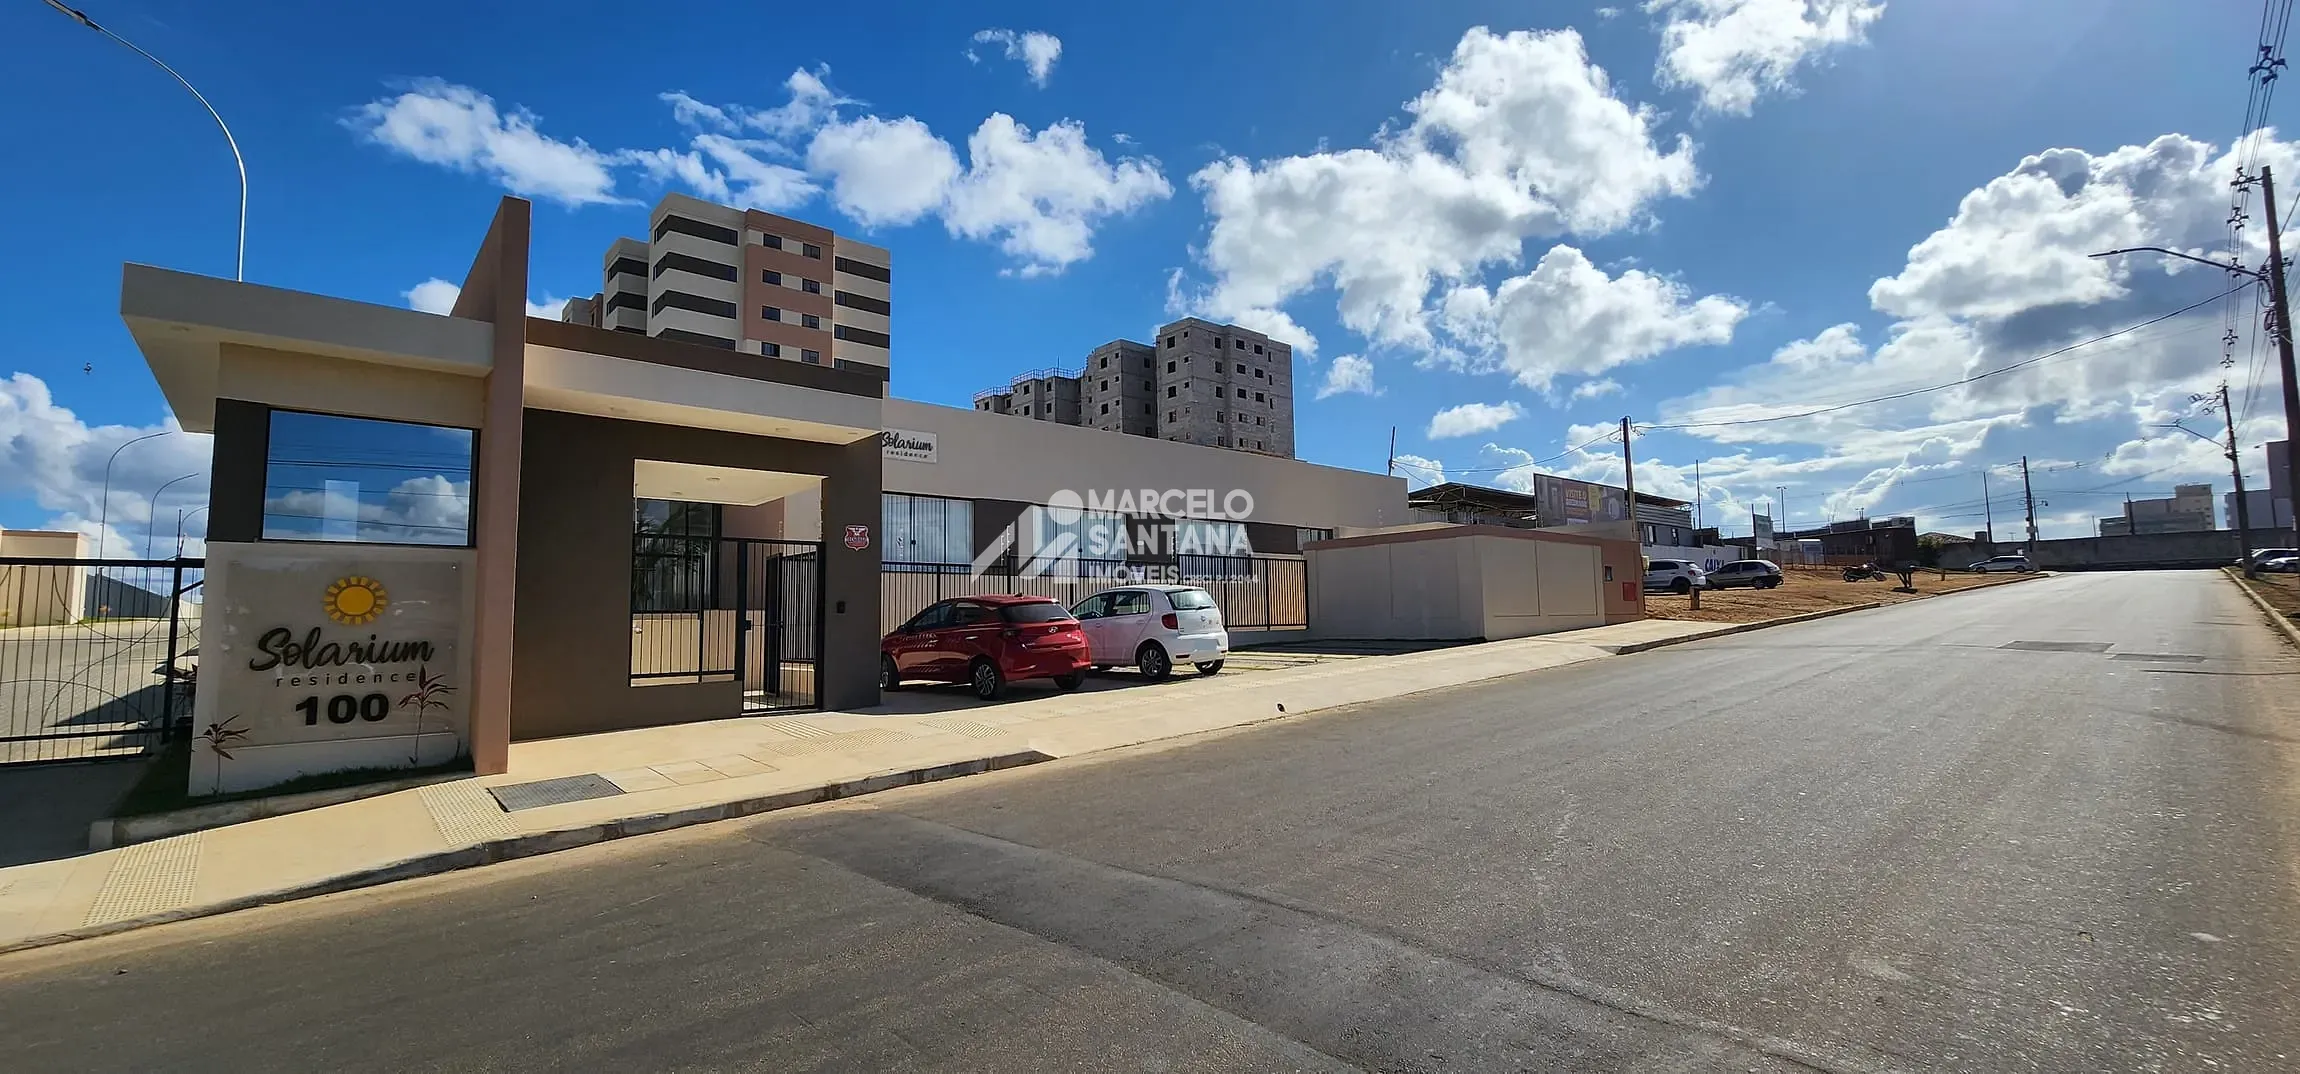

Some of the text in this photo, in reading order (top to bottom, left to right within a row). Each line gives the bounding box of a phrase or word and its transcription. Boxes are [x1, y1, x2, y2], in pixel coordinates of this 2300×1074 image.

[882, 431, 934, 451] Solarium
[886, 450, 929, 459] residence
[249, 626, 435, 672] Solarium
[276, 672, 417, 688] residence
[295, 693, 389, 726] 100
